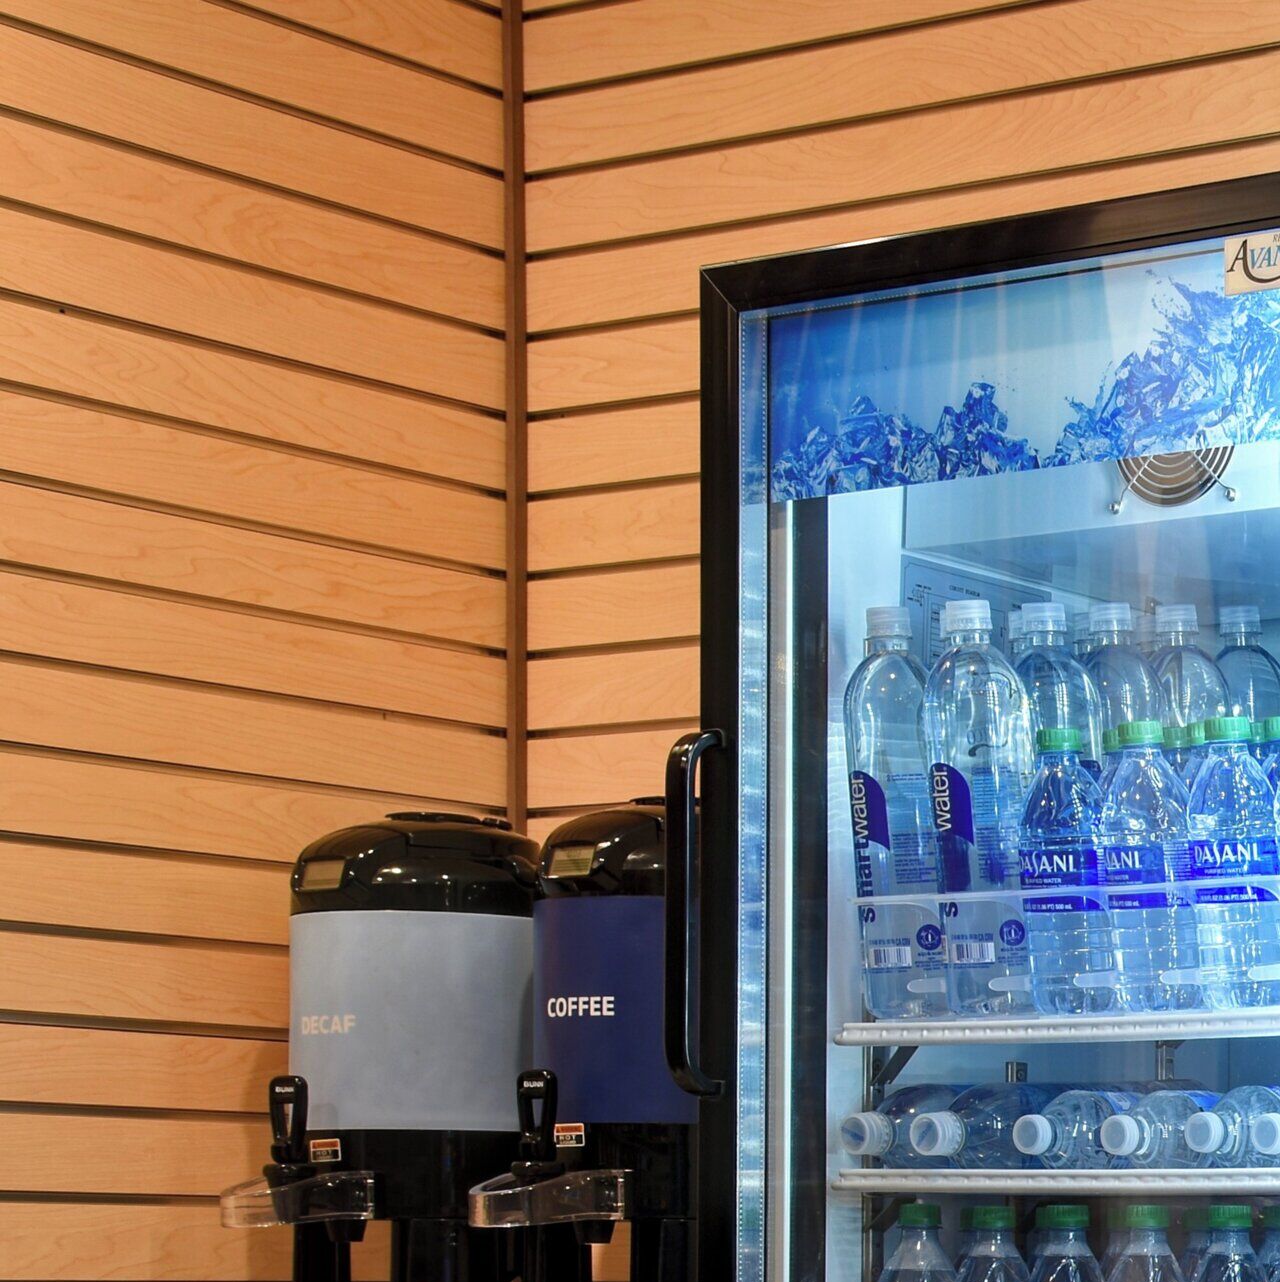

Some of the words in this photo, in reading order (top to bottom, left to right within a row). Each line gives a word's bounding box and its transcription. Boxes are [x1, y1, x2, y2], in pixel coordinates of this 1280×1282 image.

[1195, 843, 1258, 866] DASANI
[547, 996, 615, 1017] COFFEE
[302, 1015, 355, 1035] DECAF
